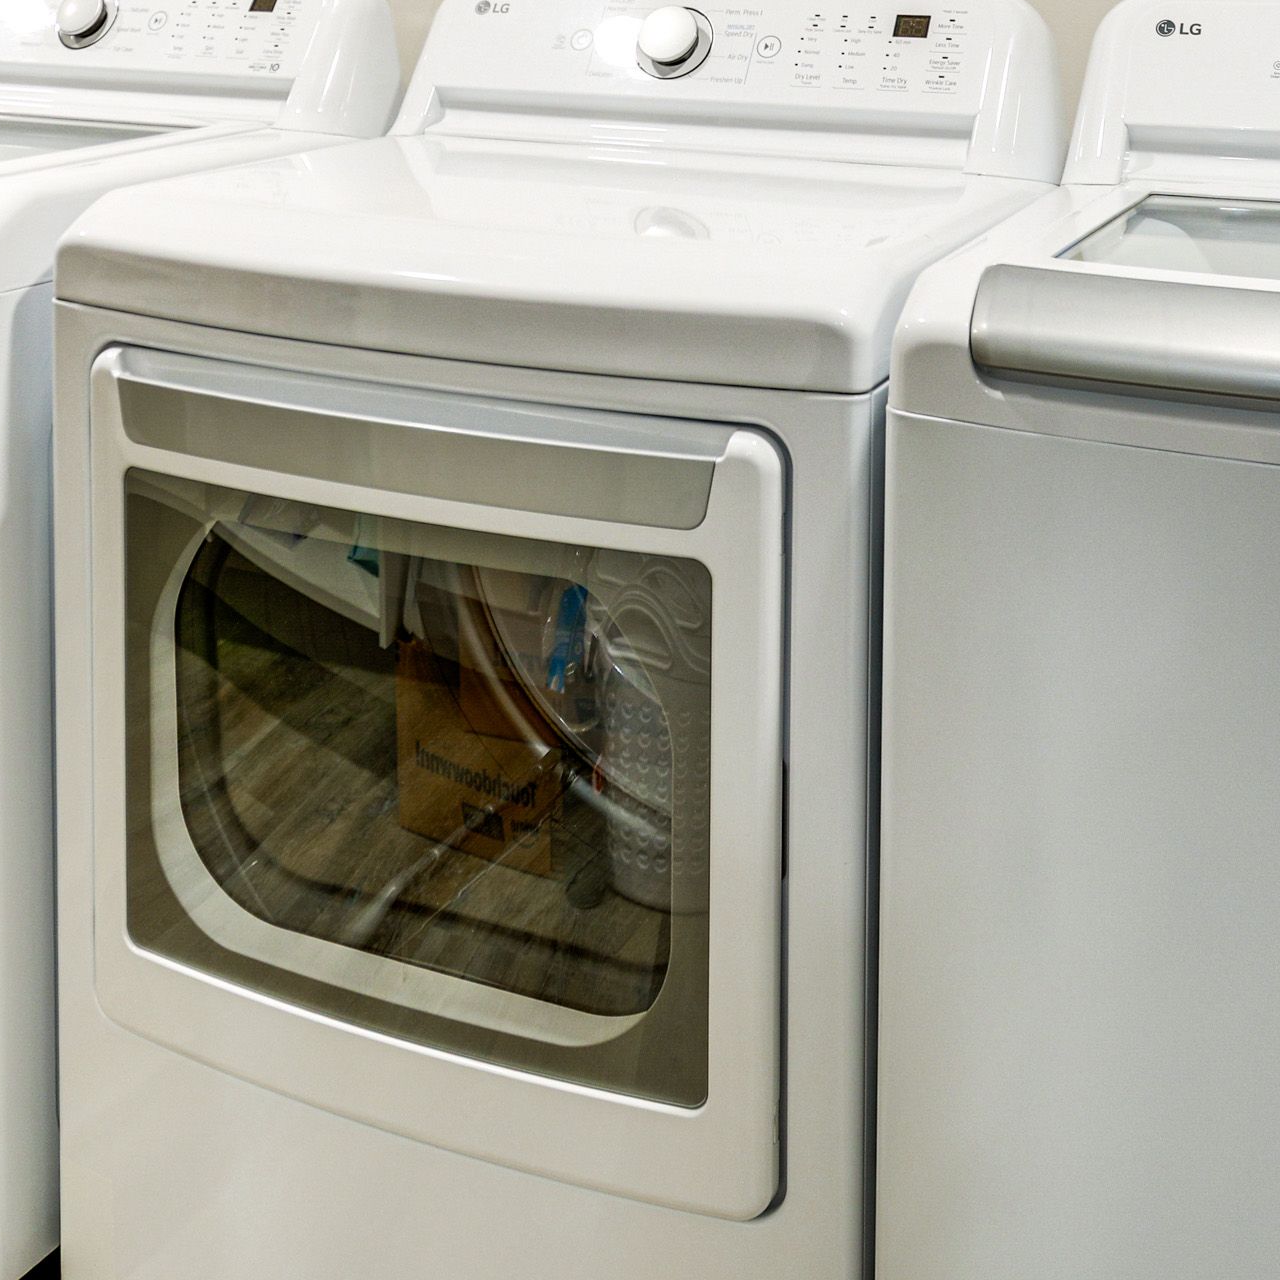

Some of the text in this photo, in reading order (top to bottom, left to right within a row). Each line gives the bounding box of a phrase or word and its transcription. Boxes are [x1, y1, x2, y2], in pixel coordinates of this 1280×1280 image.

[492, 4, 510, 14] LG
[1179, 23, 1202, 36] LG
[795, 73, 805, 81] Dry
[896, 77, 908, 85] Dry
